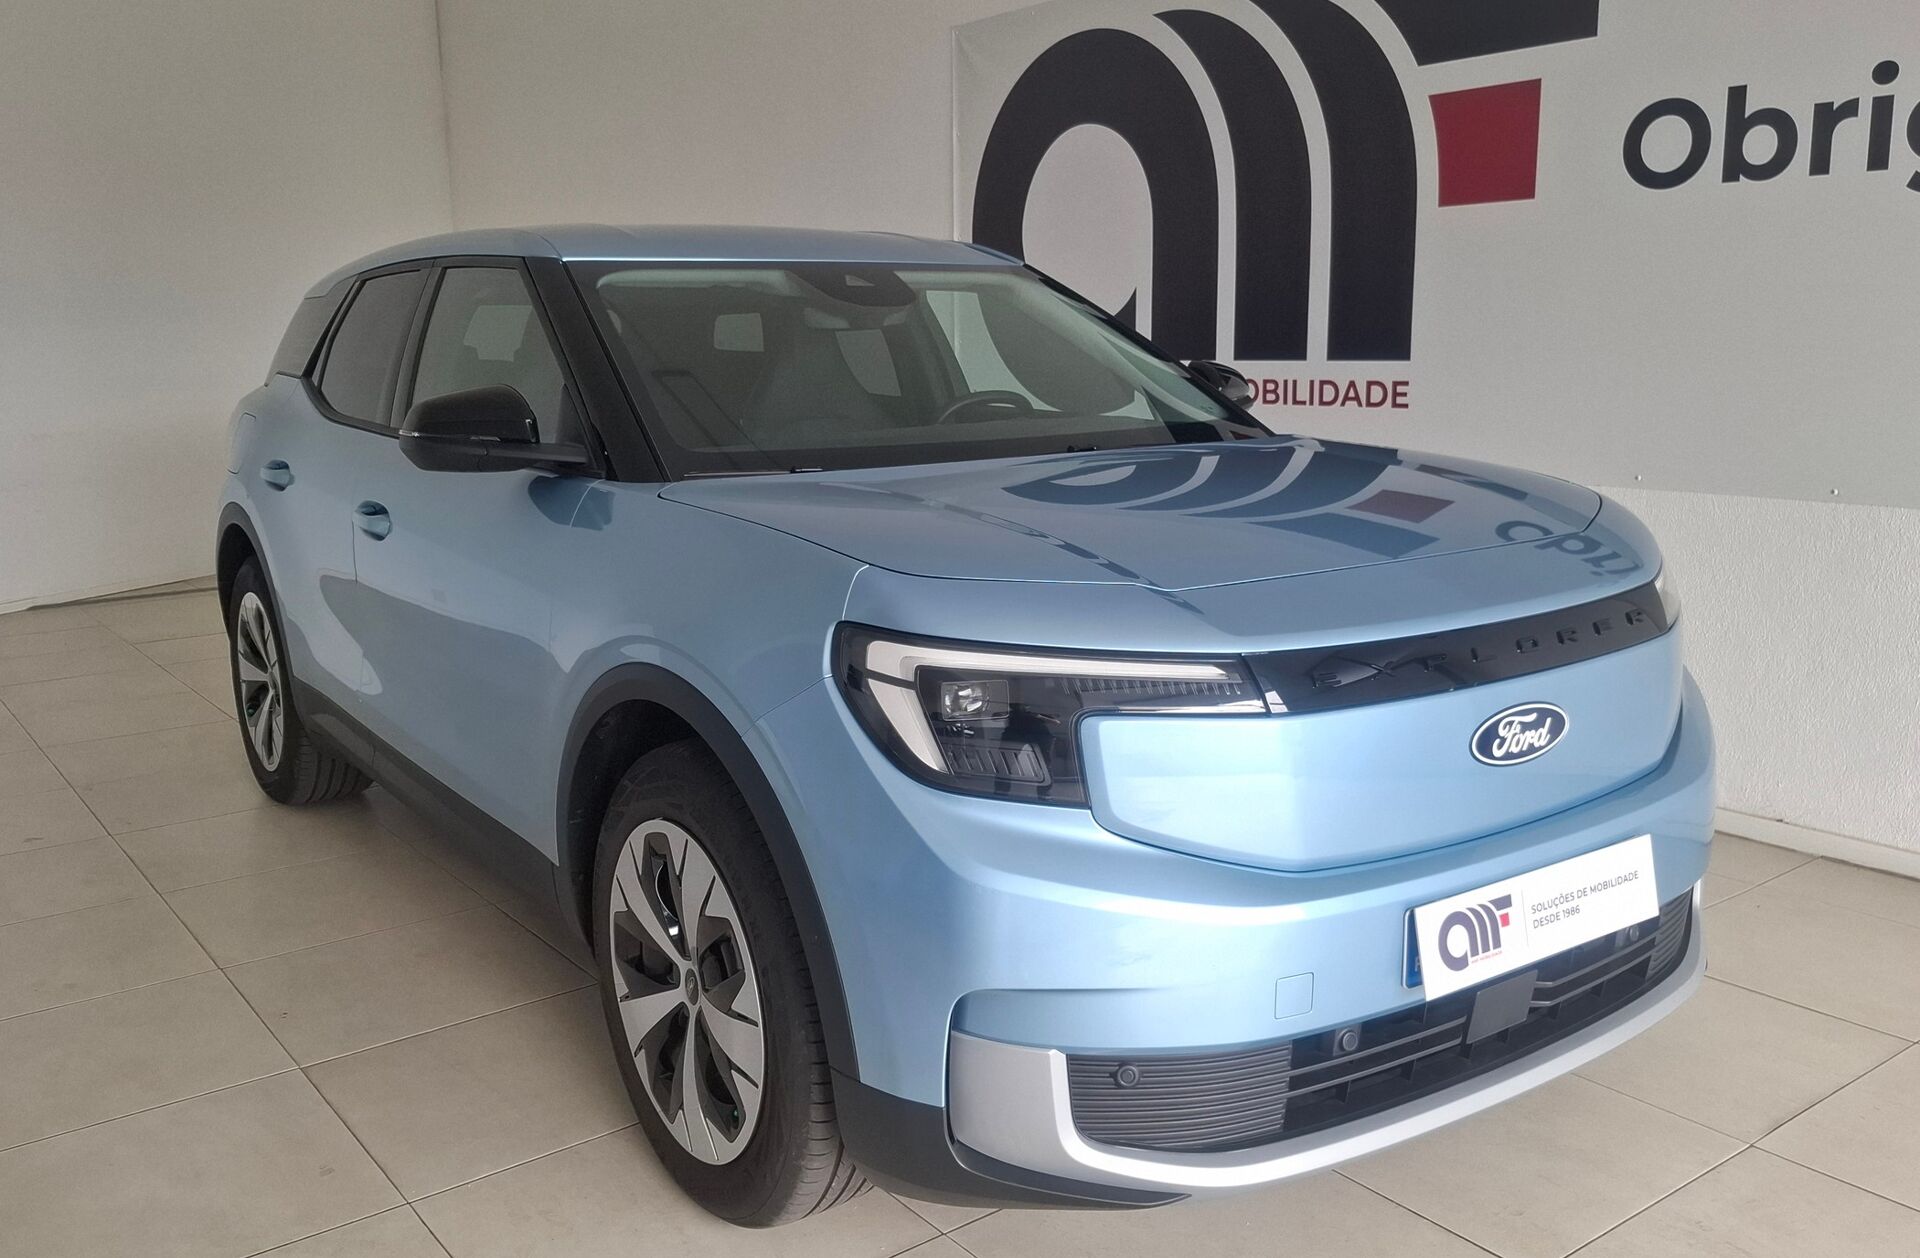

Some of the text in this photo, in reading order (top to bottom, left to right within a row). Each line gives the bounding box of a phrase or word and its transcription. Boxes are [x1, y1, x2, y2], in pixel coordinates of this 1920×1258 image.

[1622, 60, 1920, 193] Obri
[1245, 379, 1410, 409] OBILIDADE
[1492, 712, 1551, 758] Ford
[1531, 870, 1639, 914] SOLUÇÕES DE MOBILIDADE
[1533, 904, 1581, 929] DESDE 1986
